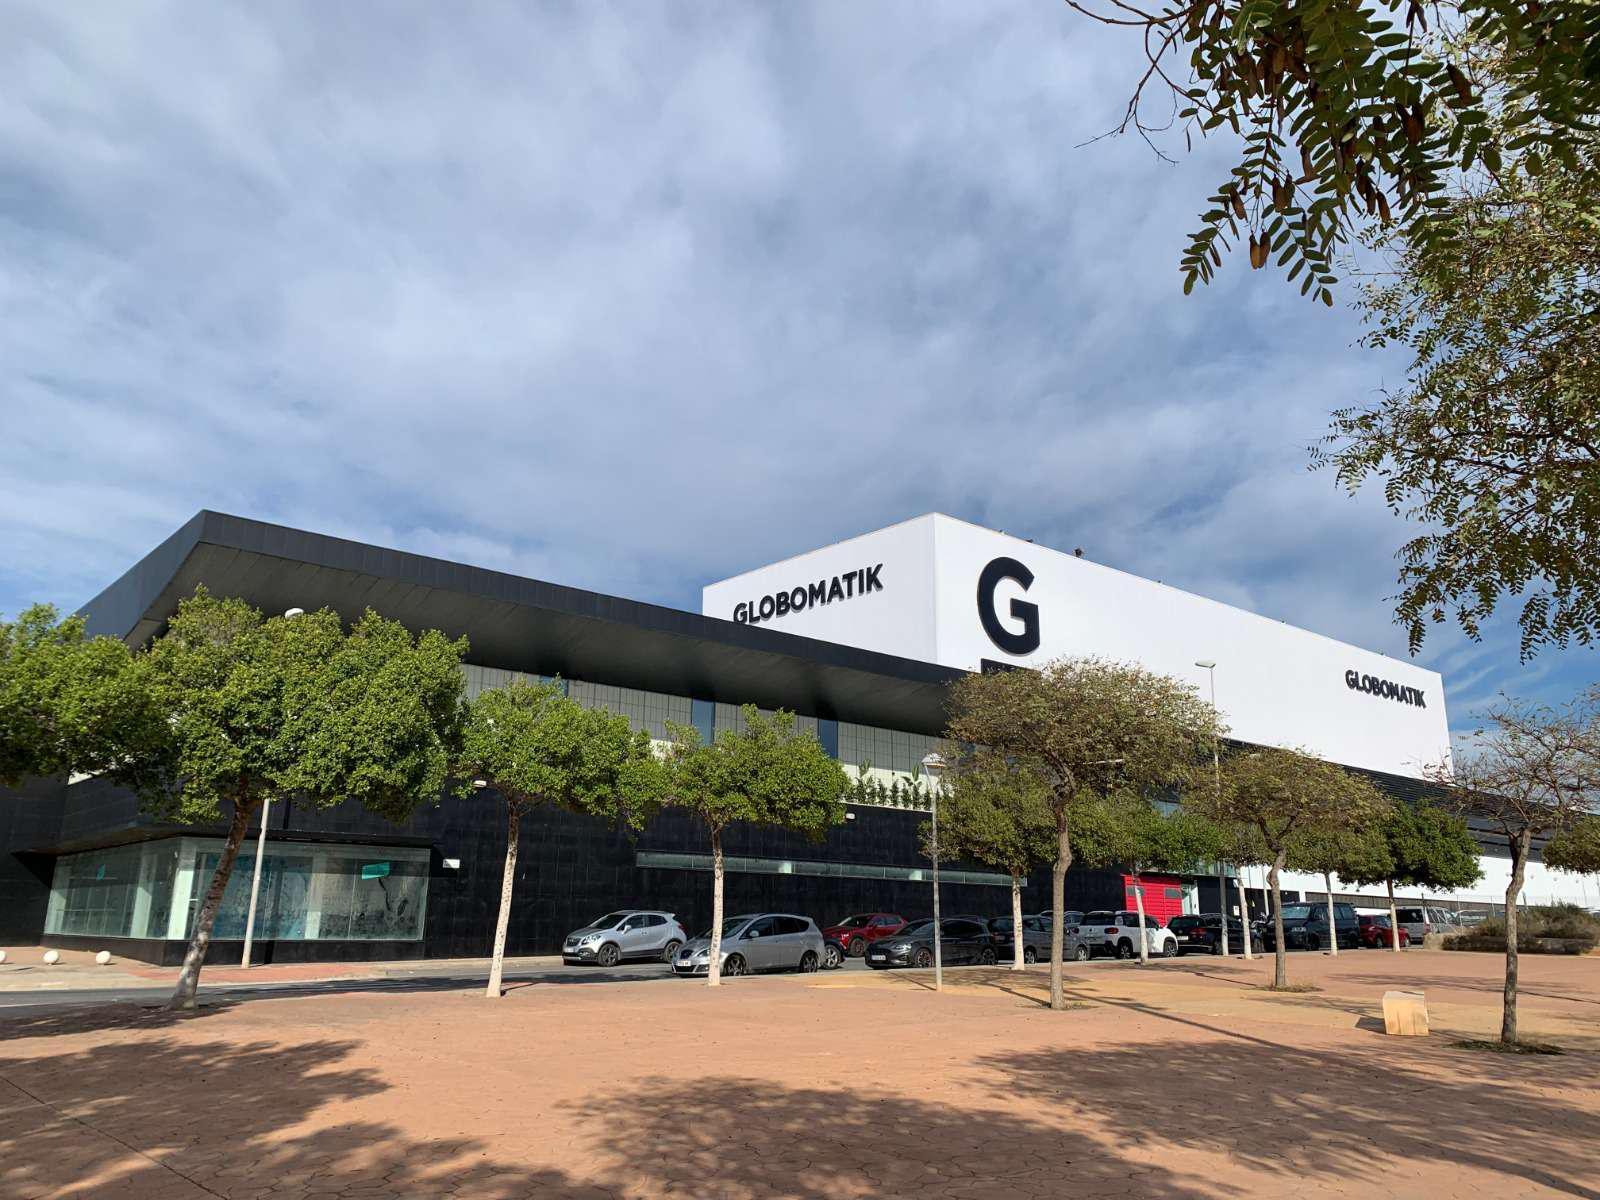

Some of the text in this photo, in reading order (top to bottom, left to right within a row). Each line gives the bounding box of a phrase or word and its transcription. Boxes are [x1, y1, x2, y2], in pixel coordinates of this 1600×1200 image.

[733, 563, 884, 624] GLOBOMATIK
[977, 556, 1041, 656] G
[1345, 669, 1427, 708] GLOBOMATIK
